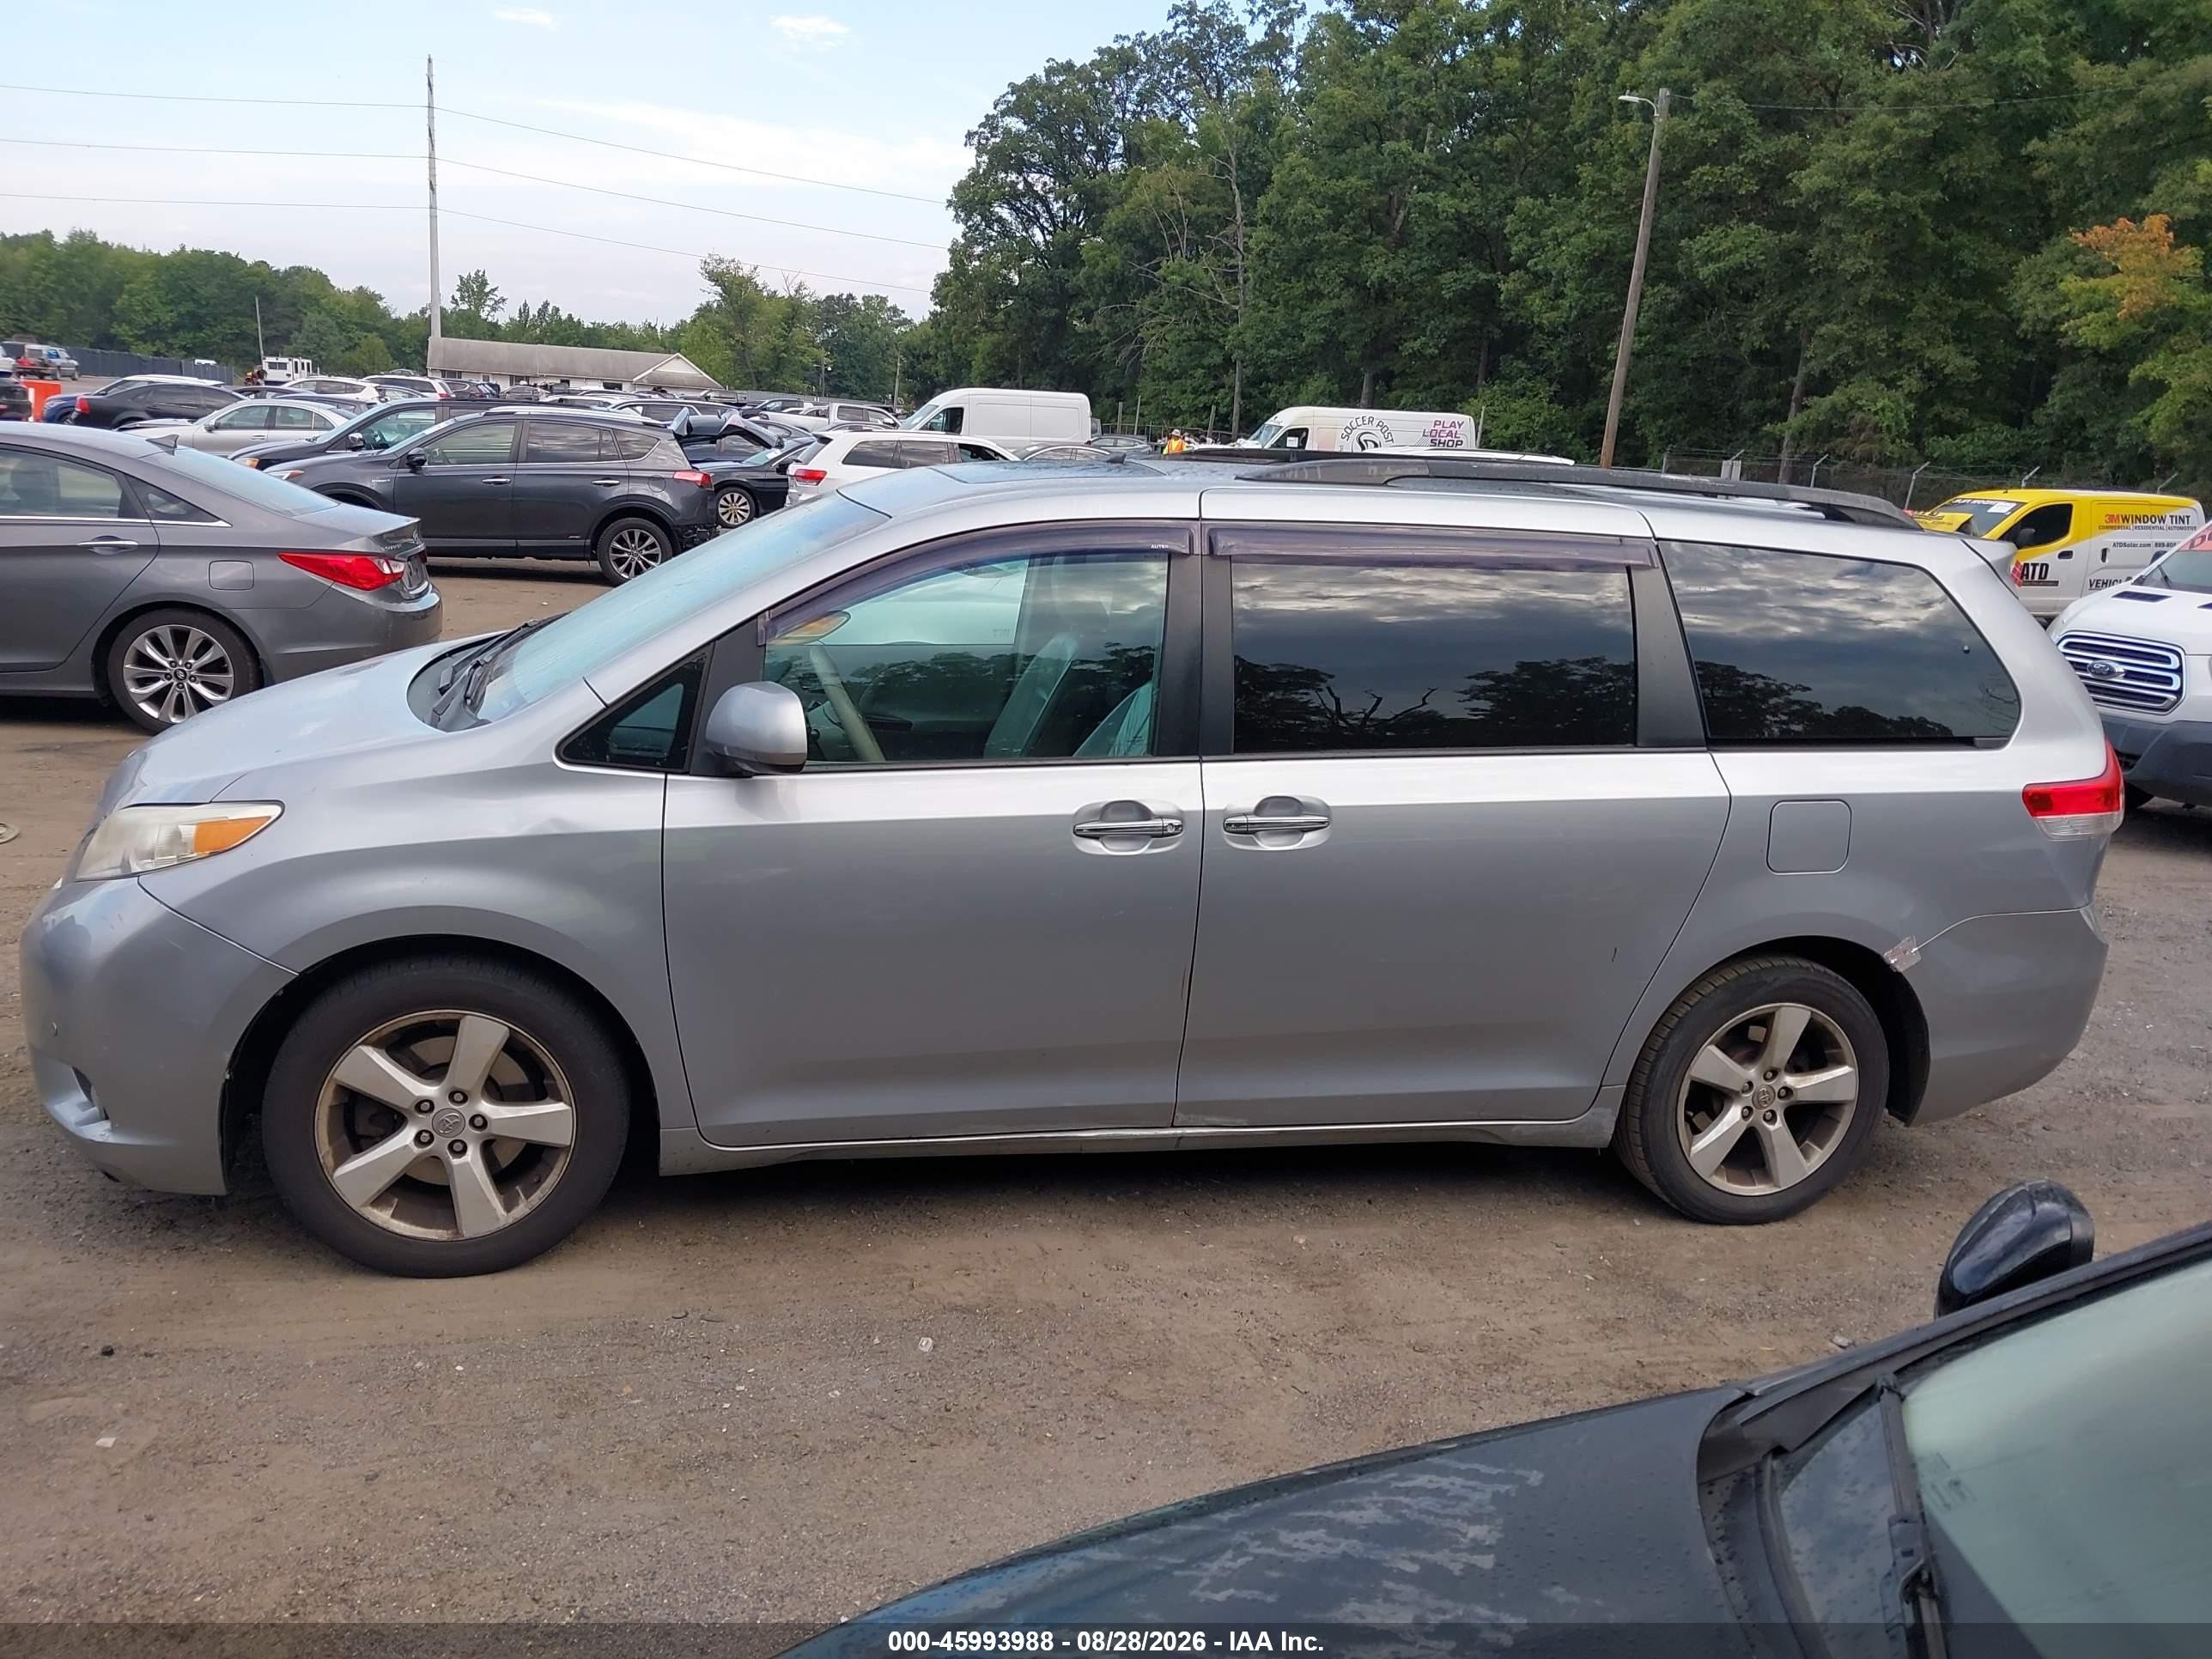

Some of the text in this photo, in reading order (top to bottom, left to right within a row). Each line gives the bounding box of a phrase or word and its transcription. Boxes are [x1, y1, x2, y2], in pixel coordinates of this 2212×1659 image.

[1340, 416, 1395, 444] SOCCER POST
[1433, 420, 1465, 429] PLAY
[1422, 428, 1461, 439] LOCAL
[1430, 438, 1464, 448] SHOP
[2105, 514, 2191, 526] 3M WINDOW TINT
[2020, 562, 2050, 580] ATD
